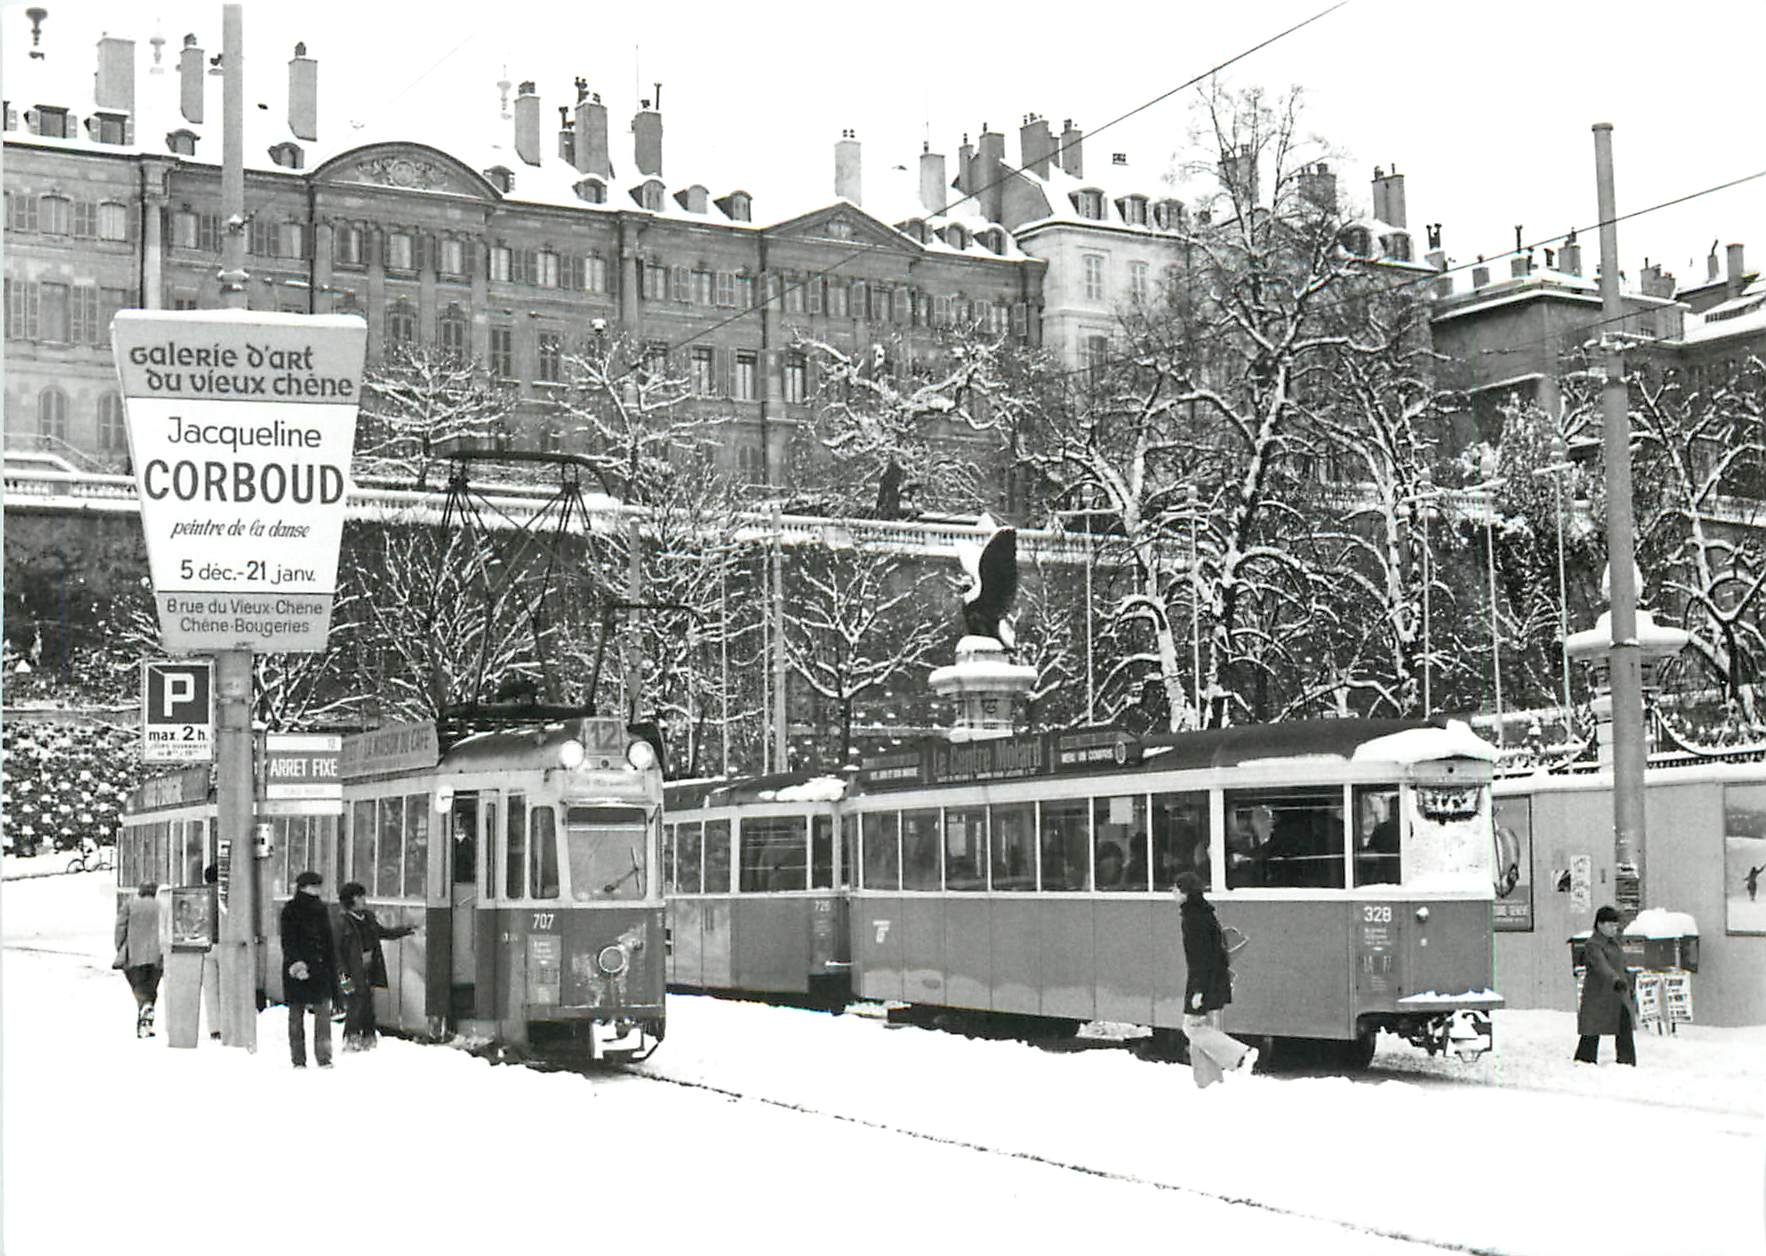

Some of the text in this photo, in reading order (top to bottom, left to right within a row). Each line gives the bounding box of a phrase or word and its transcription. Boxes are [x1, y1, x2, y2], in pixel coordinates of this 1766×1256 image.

[246, 344, 313, 371] d'art
[146, 368, 181, 391] du
[189, 370, 265, 395] vieux
[168, 416, 322, 453] Jacqueline
[144, 459, 344, 504] CORBOUD
[170, 517, 310, 539] peintre de la danse
[180, 559, 193, 580] 5
[270, 565, 316, 585] janv.
[167, 597, 177, 613] 8
[179, 599, 204, 614] rue
[208, 599, 227, 615] du
[164, 673, 195, 717] P
[183, 726, 194, 741] 2
[591, 721, 618, 750] 12
[271, 758, 338, 776] ARRET FIXE
[533, 913, 554, 929] 707
[1363, 906, 1392, 922] 328
